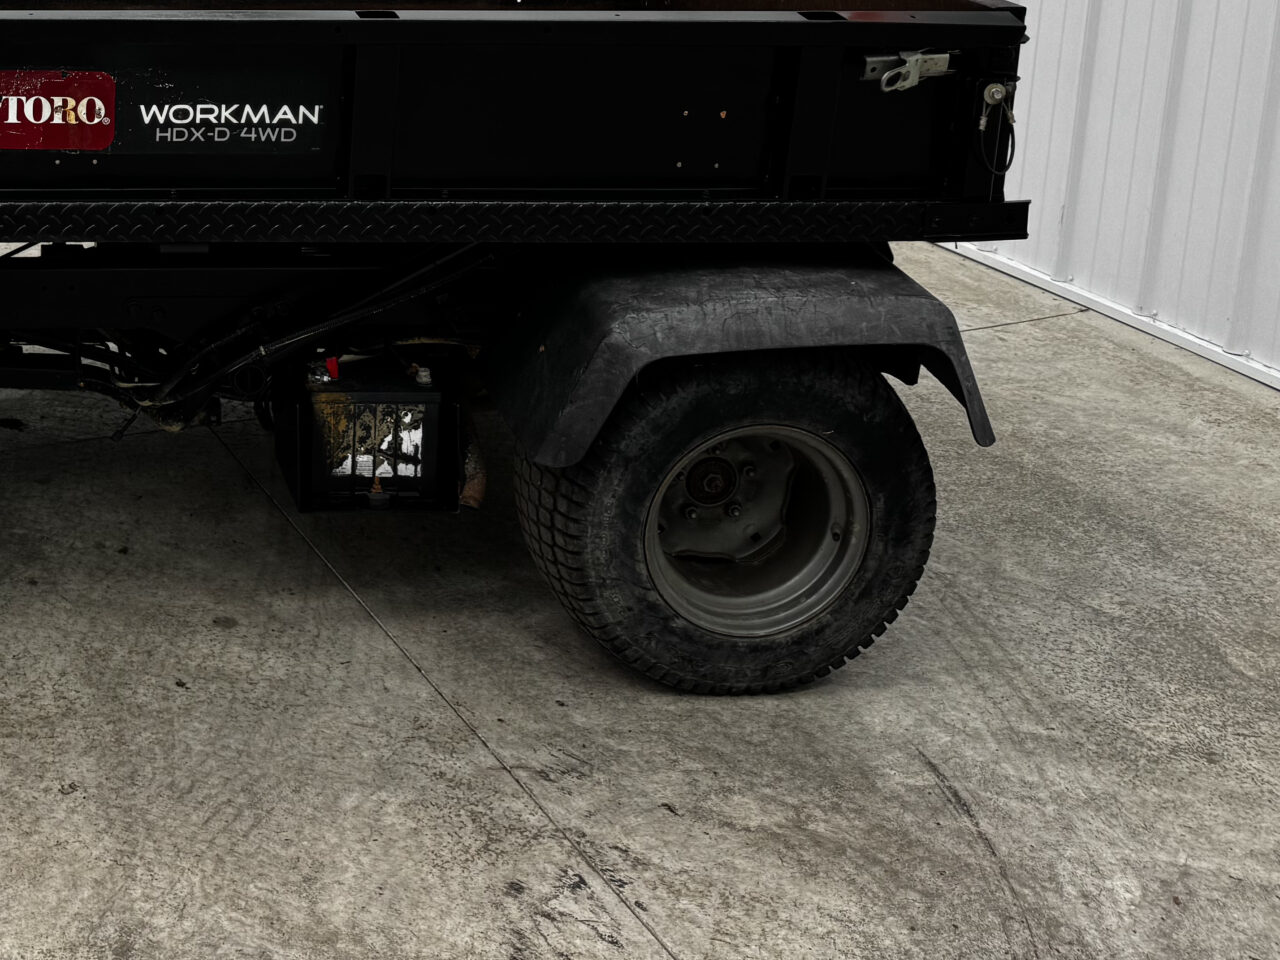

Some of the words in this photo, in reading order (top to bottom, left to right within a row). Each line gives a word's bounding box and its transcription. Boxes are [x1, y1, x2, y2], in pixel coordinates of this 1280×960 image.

[0, 95, 106, 125] TORO
[140, 104, 320, 124] WORKMAN
[155, 127, 231, 142] HDX-D
[240, 127, 297, 142] 4WD
